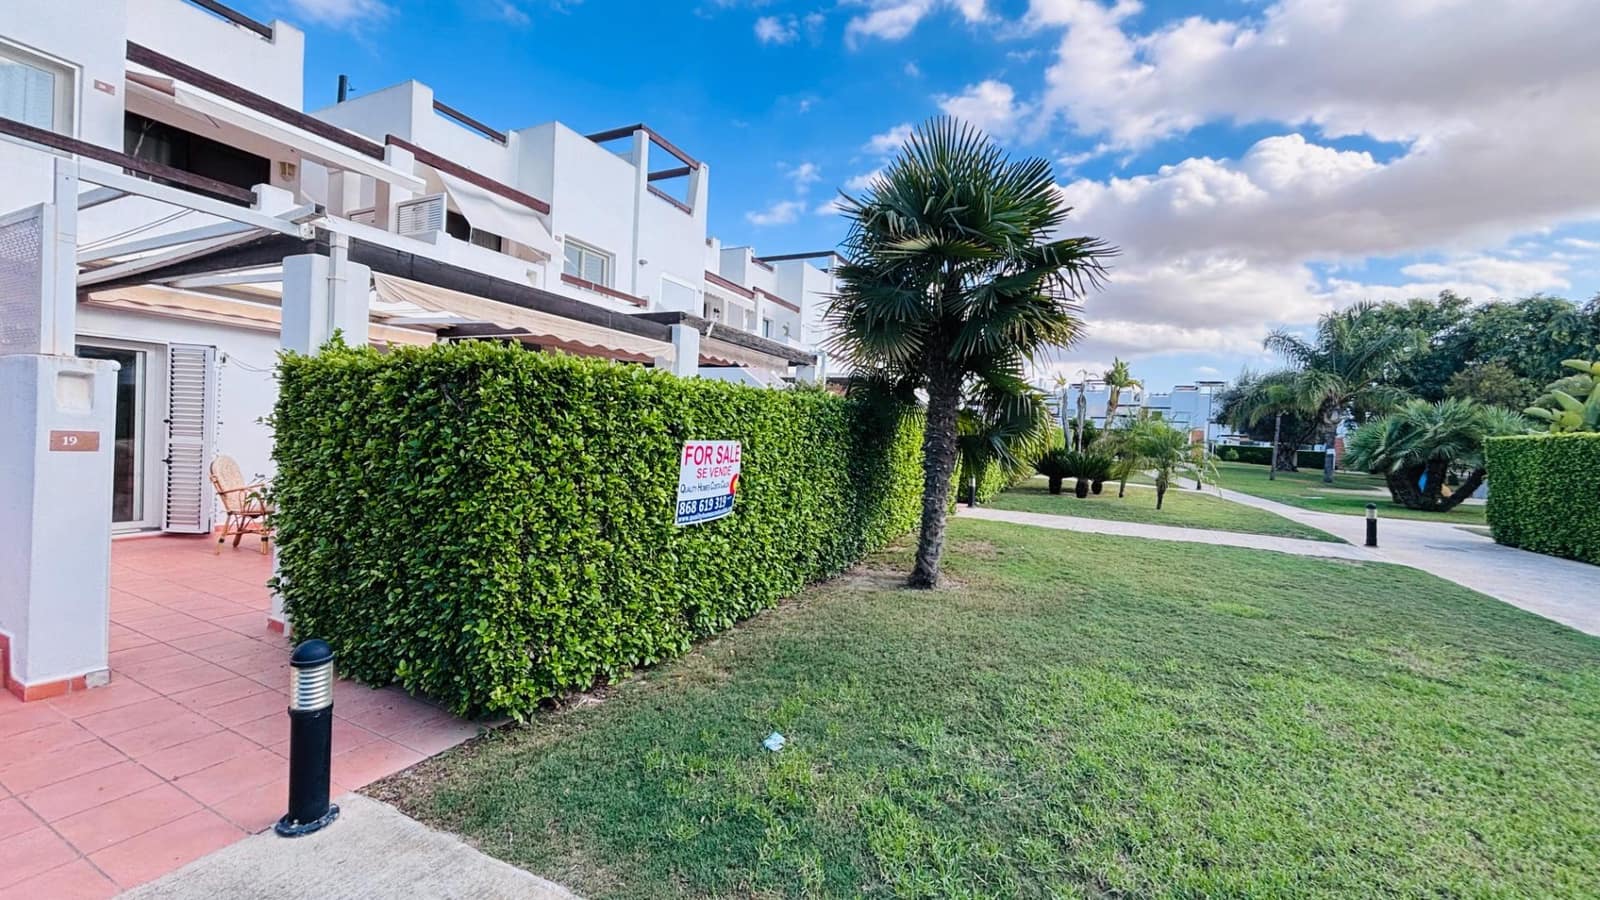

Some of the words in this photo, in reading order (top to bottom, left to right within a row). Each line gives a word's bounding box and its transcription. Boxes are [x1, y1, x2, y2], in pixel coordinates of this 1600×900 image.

[63, 436, 78, 446] 19
[684, 445, 713, 466] FOR
[716, 445, 741, 465] SALE
[696, 467, 708, 479] SE
[709, 466, 732, 478] VENDE
[679, 501, 697, 515] 868
[698, 498, 714, 513] 619
[714, 496, 727, 509] 319
